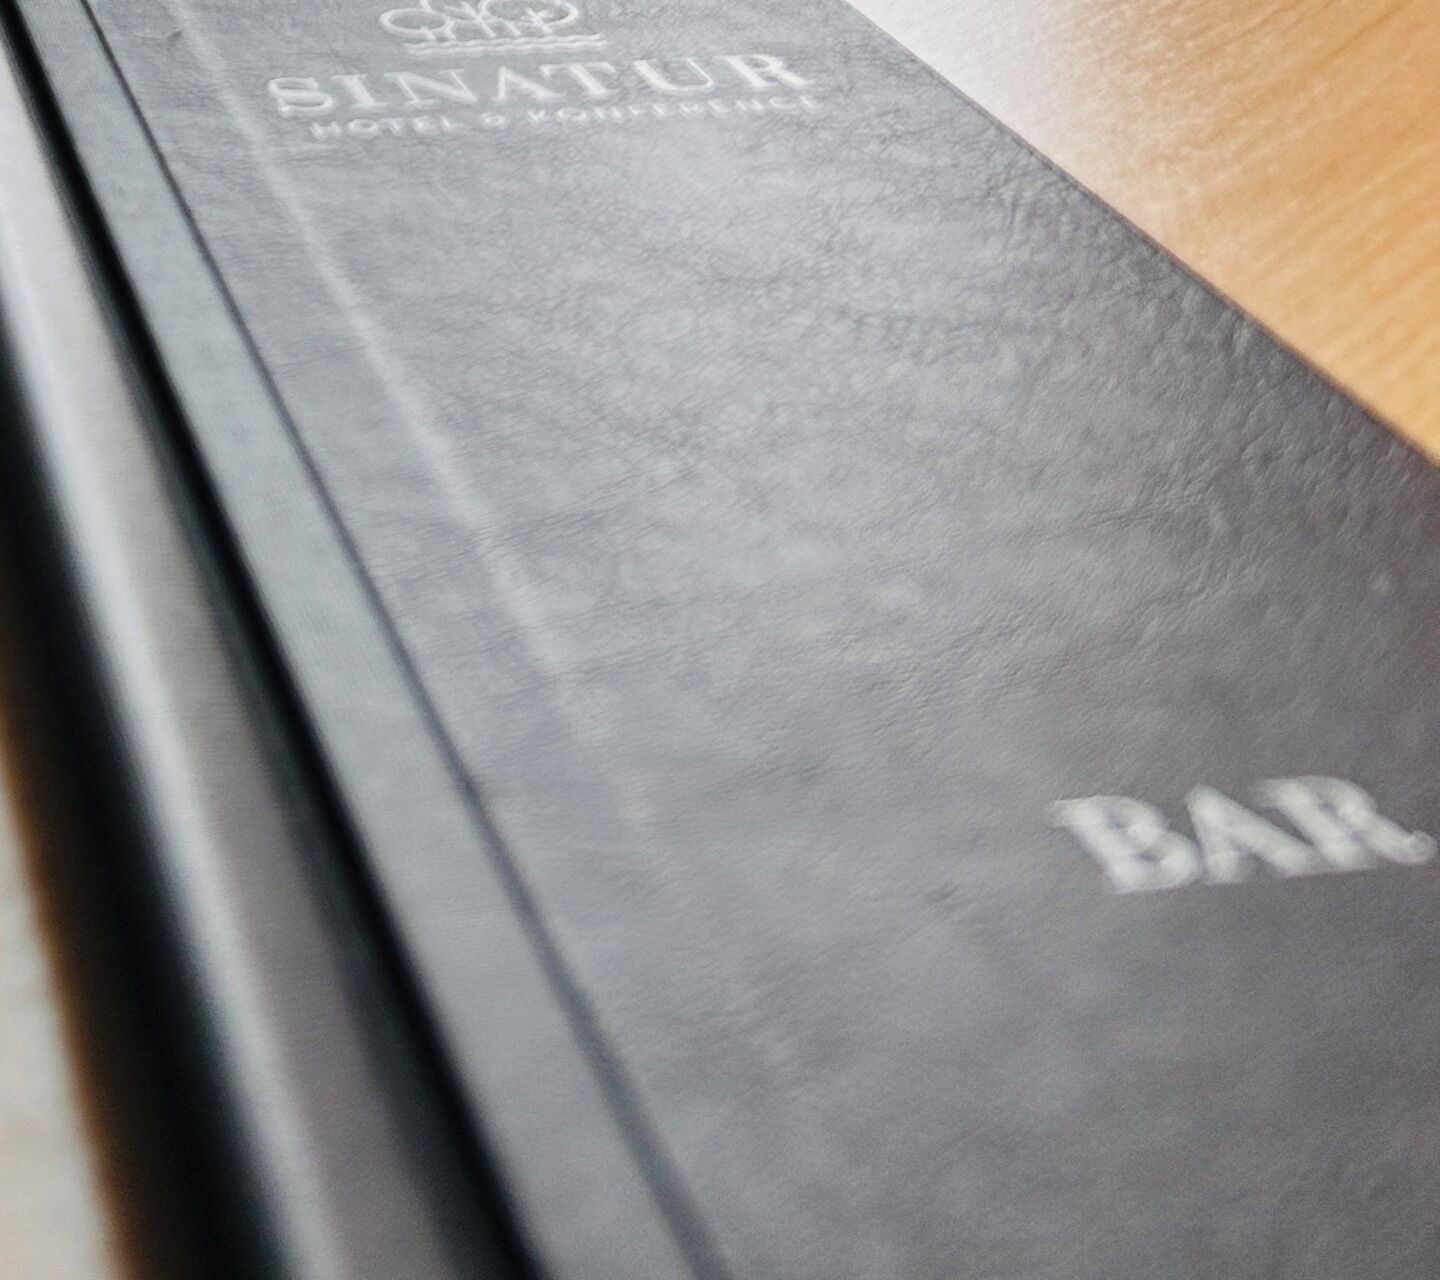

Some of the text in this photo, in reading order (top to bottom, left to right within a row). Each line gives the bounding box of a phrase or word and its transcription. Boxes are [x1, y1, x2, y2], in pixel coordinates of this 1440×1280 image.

[266, 51, 816, 119] SINATUR
[308, 114, 461, 140] HOTEL
[1052, 774, 1433, 896] BAR
